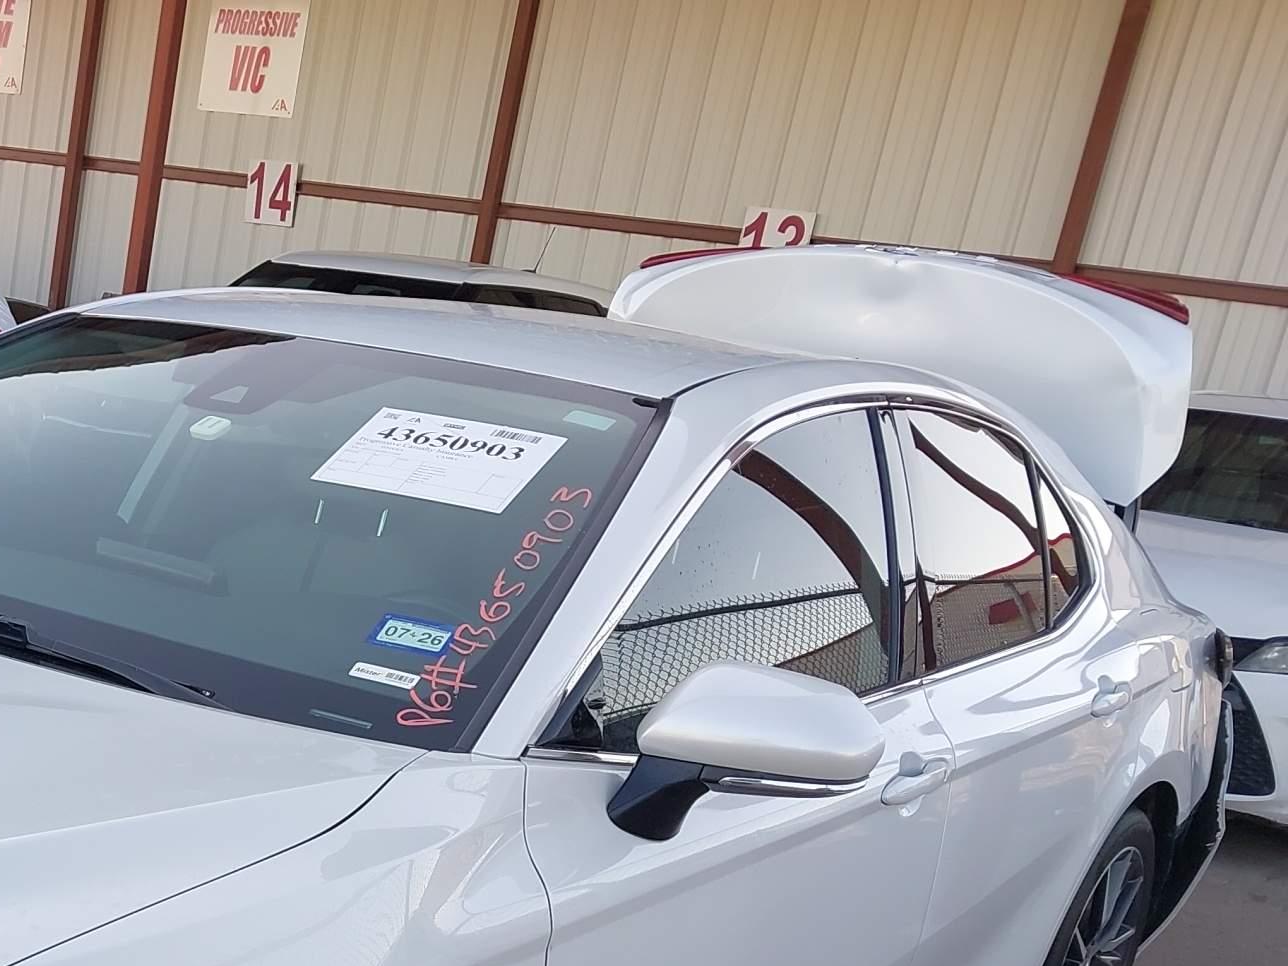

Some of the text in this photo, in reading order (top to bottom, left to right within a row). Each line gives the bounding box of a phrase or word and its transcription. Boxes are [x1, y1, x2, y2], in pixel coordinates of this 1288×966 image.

[214, 8, 302, 38] PROGRESSIVE
[228, 45, 272, 94] VIC
[249, 161, 293, 222] 14
[376, 425, 526, 461] 43650903
